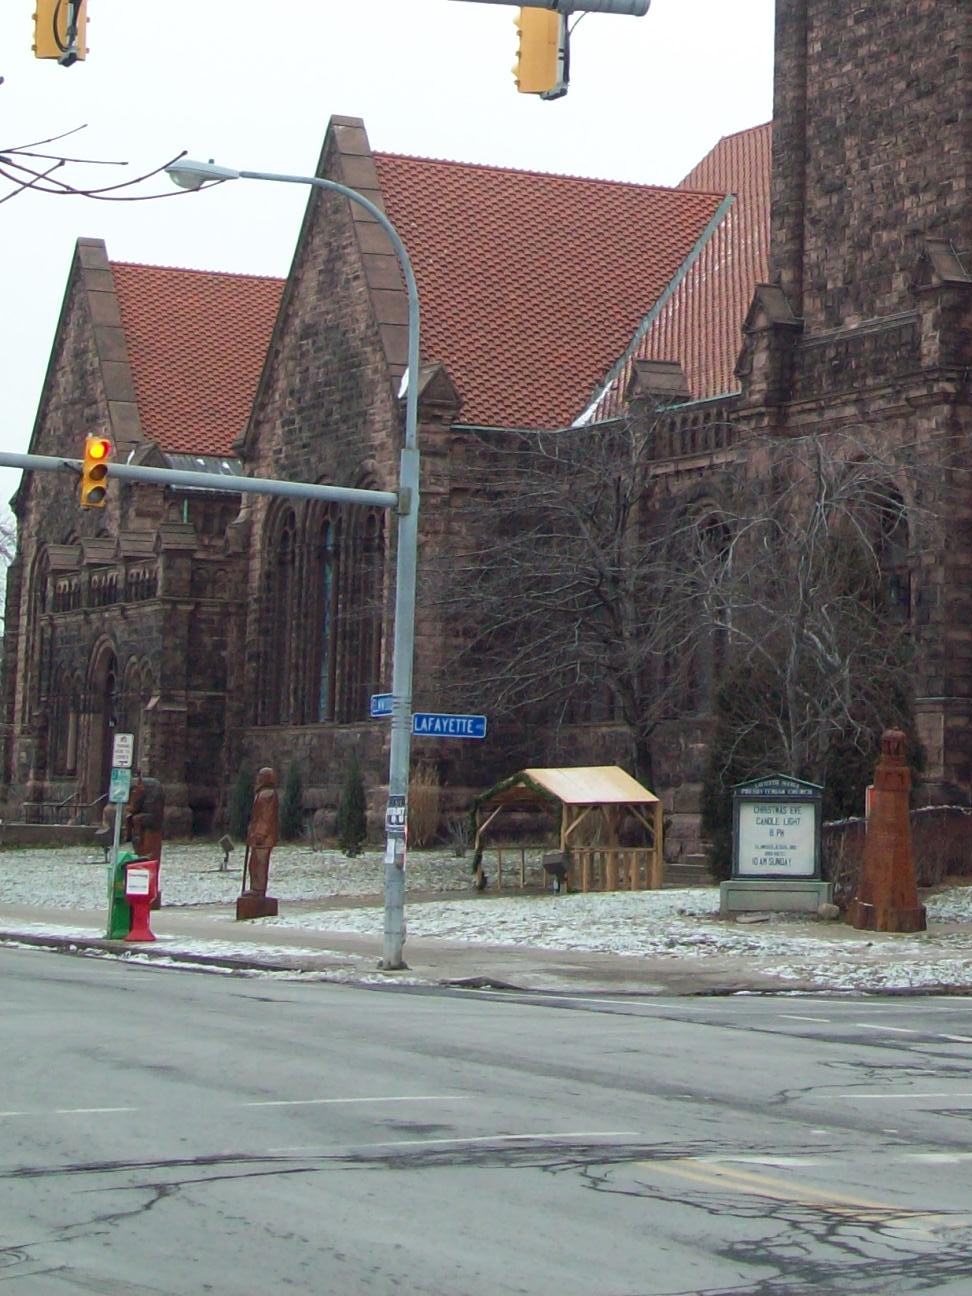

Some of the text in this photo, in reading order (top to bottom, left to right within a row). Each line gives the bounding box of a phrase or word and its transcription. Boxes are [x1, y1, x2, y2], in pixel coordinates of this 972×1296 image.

[414, 717, 474, 733] LAFAYETTE
[753, 806, 802, 815] CHRISTMAS EVE
[756, 817, 800, 825] CANDLE LIGHT
[776, 829, 784, 837] PM
[759, 857, 767, 865] AM
[768, 857, 791, 866] SUNDAY
